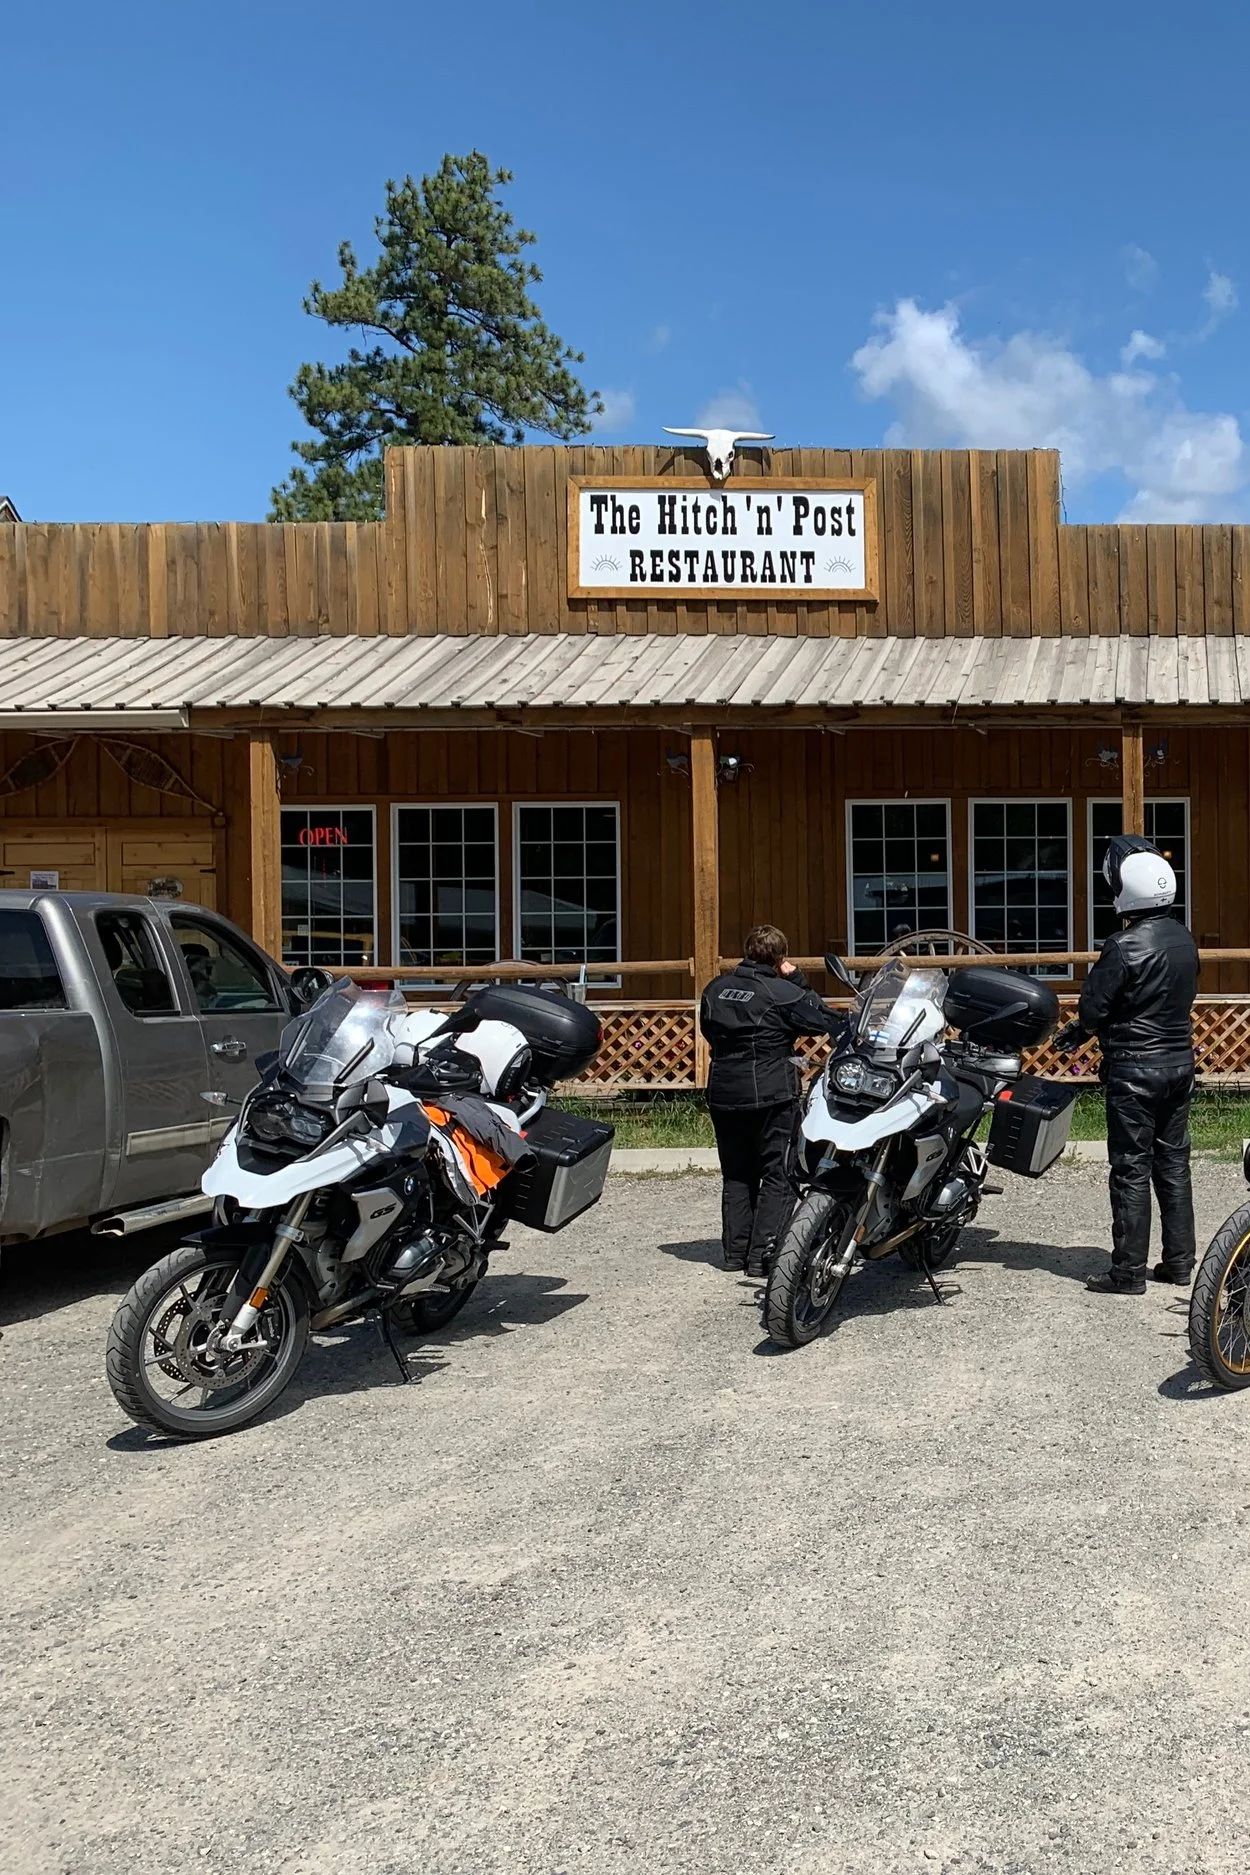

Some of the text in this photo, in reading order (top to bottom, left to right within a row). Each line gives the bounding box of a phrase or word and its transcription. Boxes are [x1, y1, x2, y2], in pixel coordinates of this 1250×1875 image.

[590, 494, 641, 535] The
[657, 494, 737, 536] Hitch
[792, 495, 857, 537] Post
[629, 549, 816, 584] RESTAURANT
[299, 826, 348, 847] OPEN
